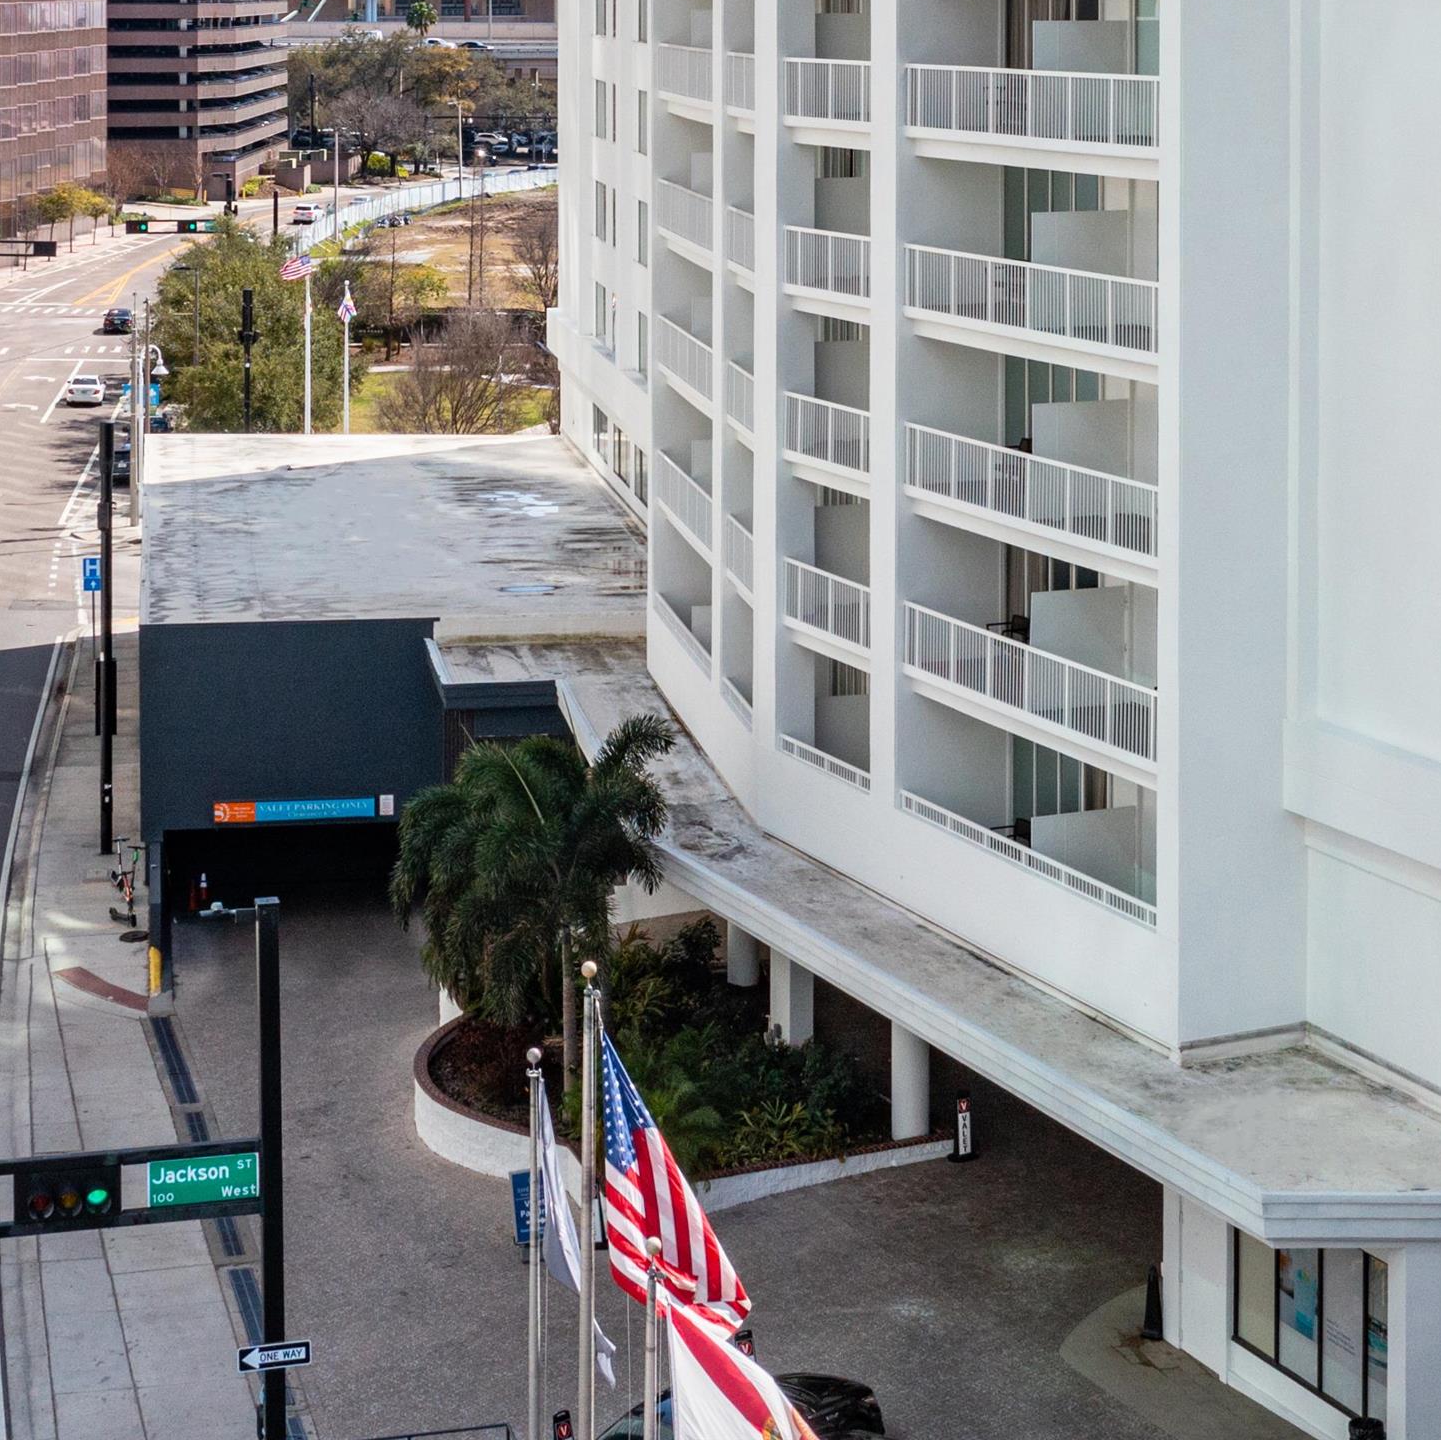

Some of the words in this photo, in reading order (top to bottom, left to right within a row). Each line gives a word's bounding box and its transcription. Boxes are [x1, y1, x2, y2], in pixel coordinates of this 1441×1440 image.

[85, 559, 100, 577] H
[294, 802, 340, 811] PARKING
[341, 801, 368, 809] ONLY
[152, 1165, 230, 1185] Jackson
[237, 1159, 253, 1169] ST
[153, 1193, 174, 1203] 100
[221, 1184, 256, 1198] West
[260, 1351, 279, 1362] ONE
[282, 1348, 303, 1359] WAY
